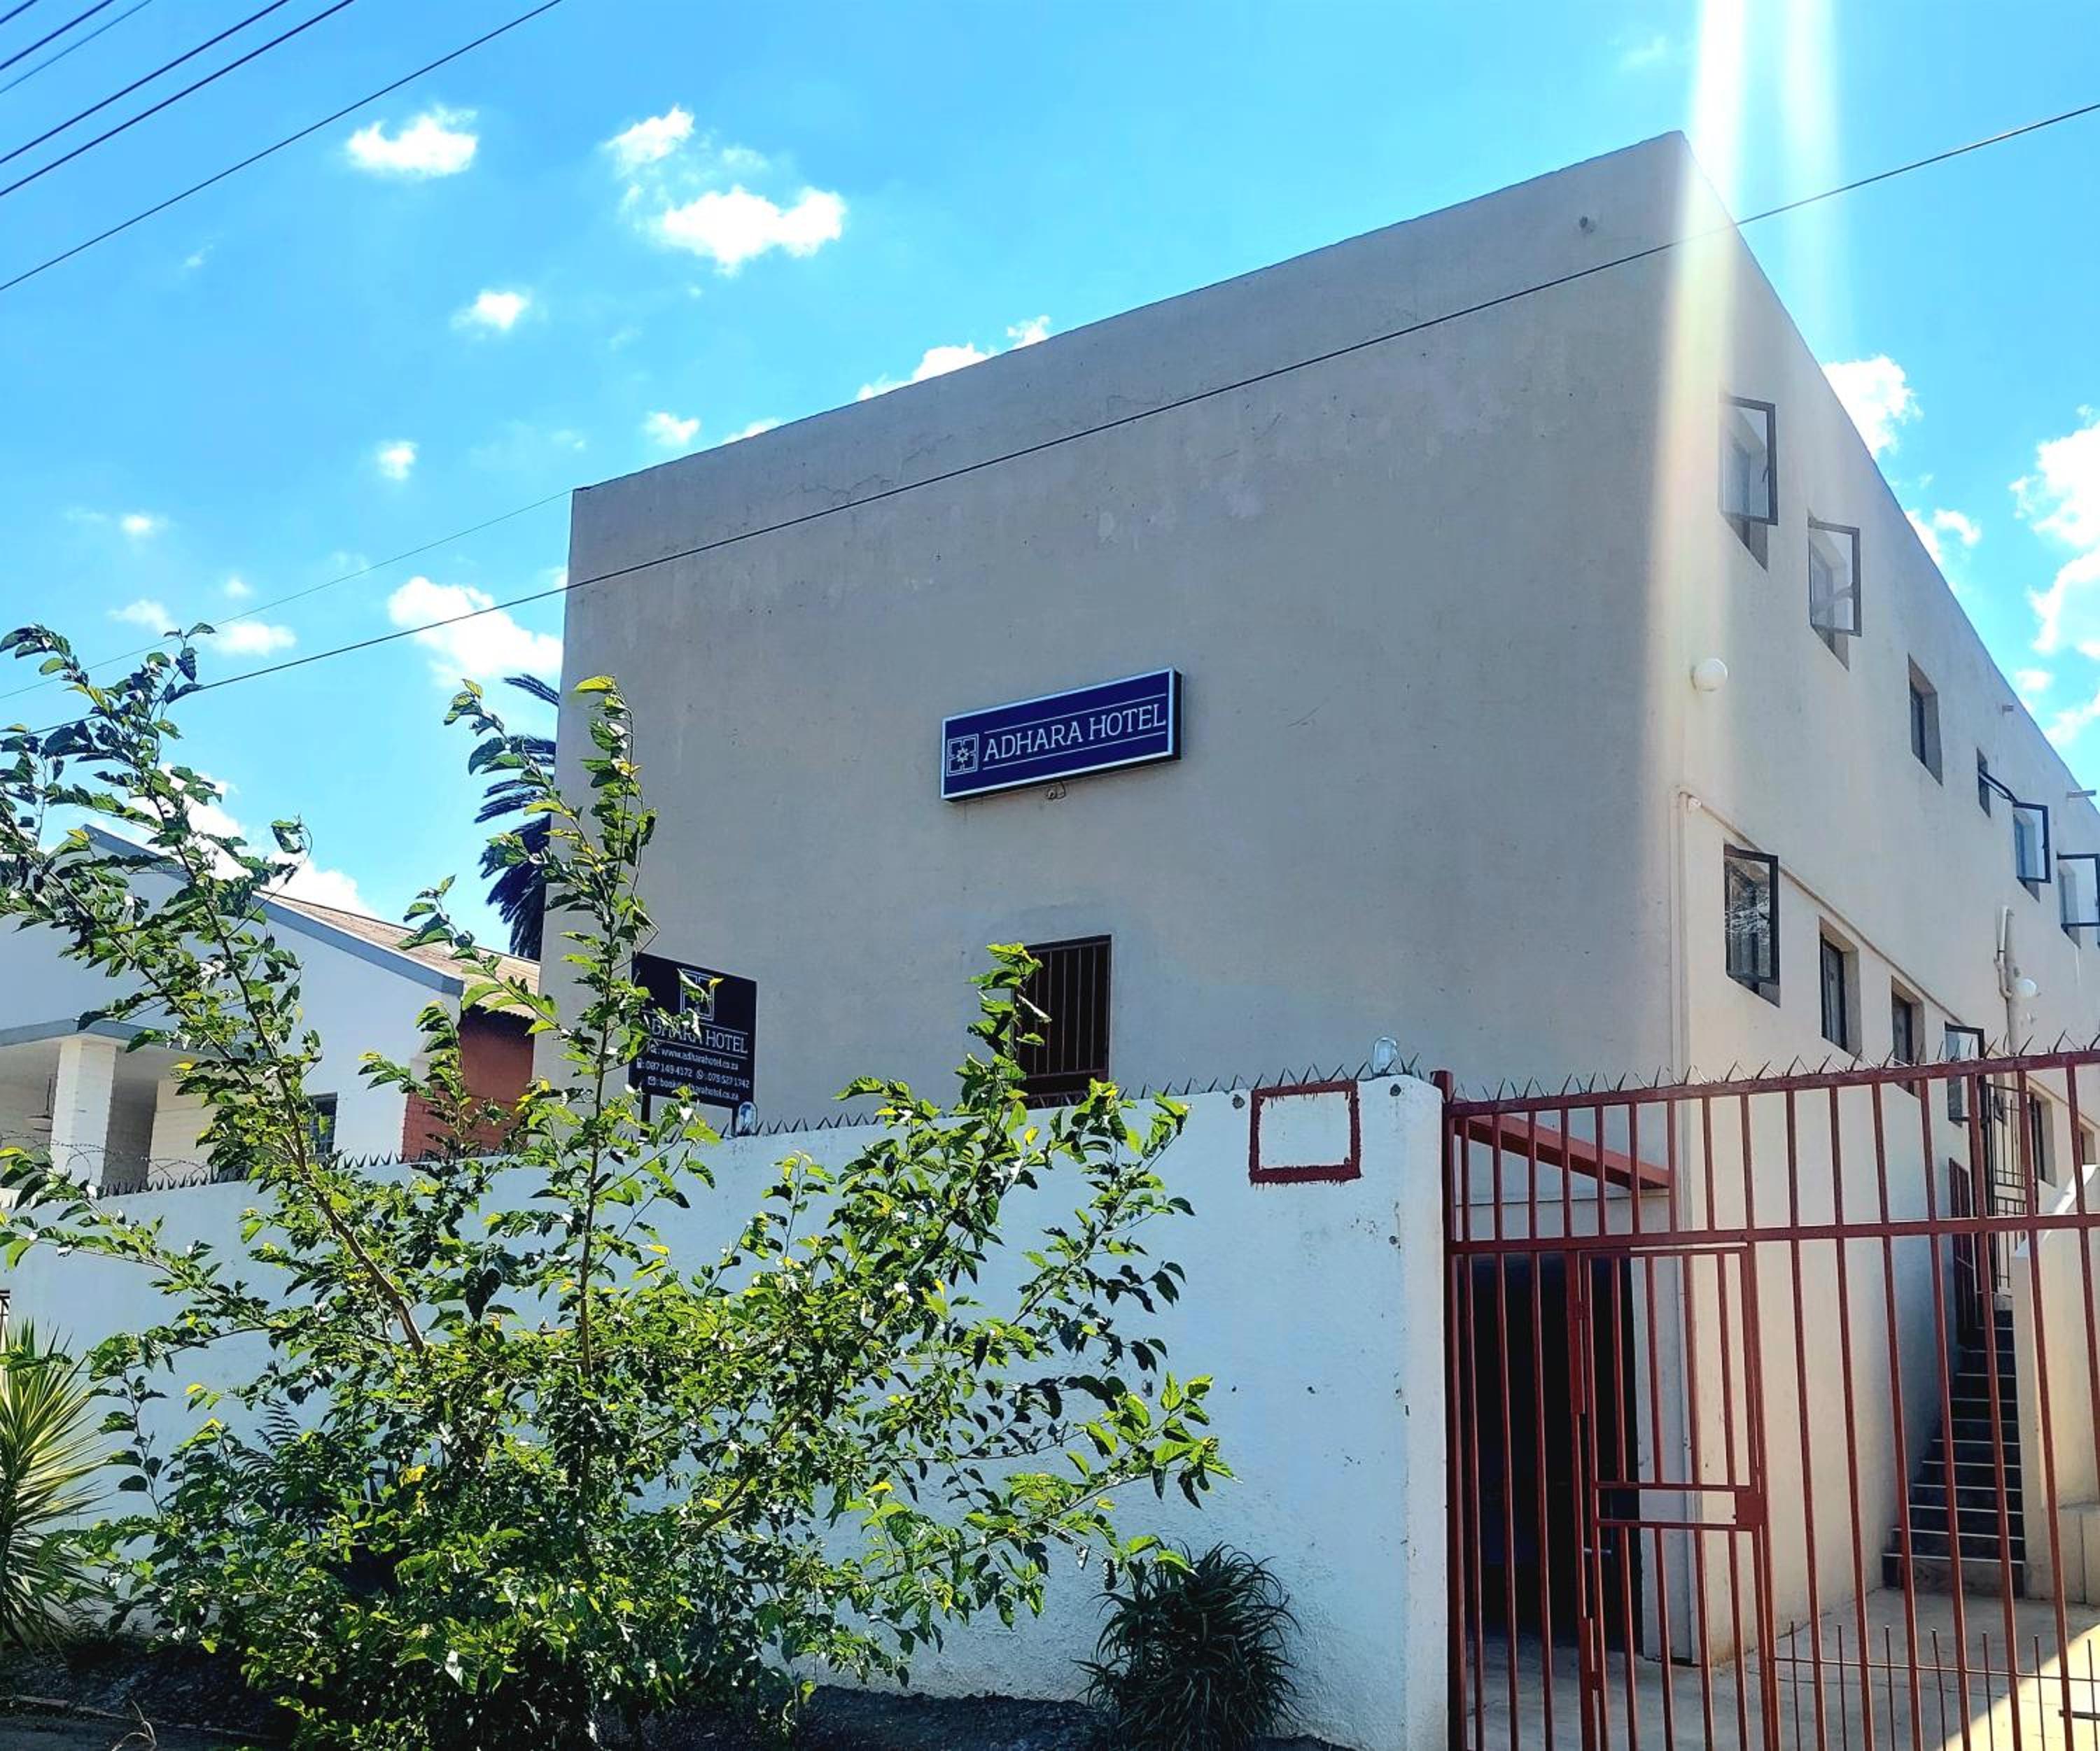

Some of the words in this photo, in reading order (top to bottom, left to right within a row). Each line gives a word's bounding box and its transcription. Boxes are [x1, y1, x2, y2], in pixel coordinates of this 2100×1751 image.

[983, 720, 1084, 762] ADHARA
[1088, 703, 1167, 740] HOTEL
[706, 1030, 748, 1054] HOTEL
